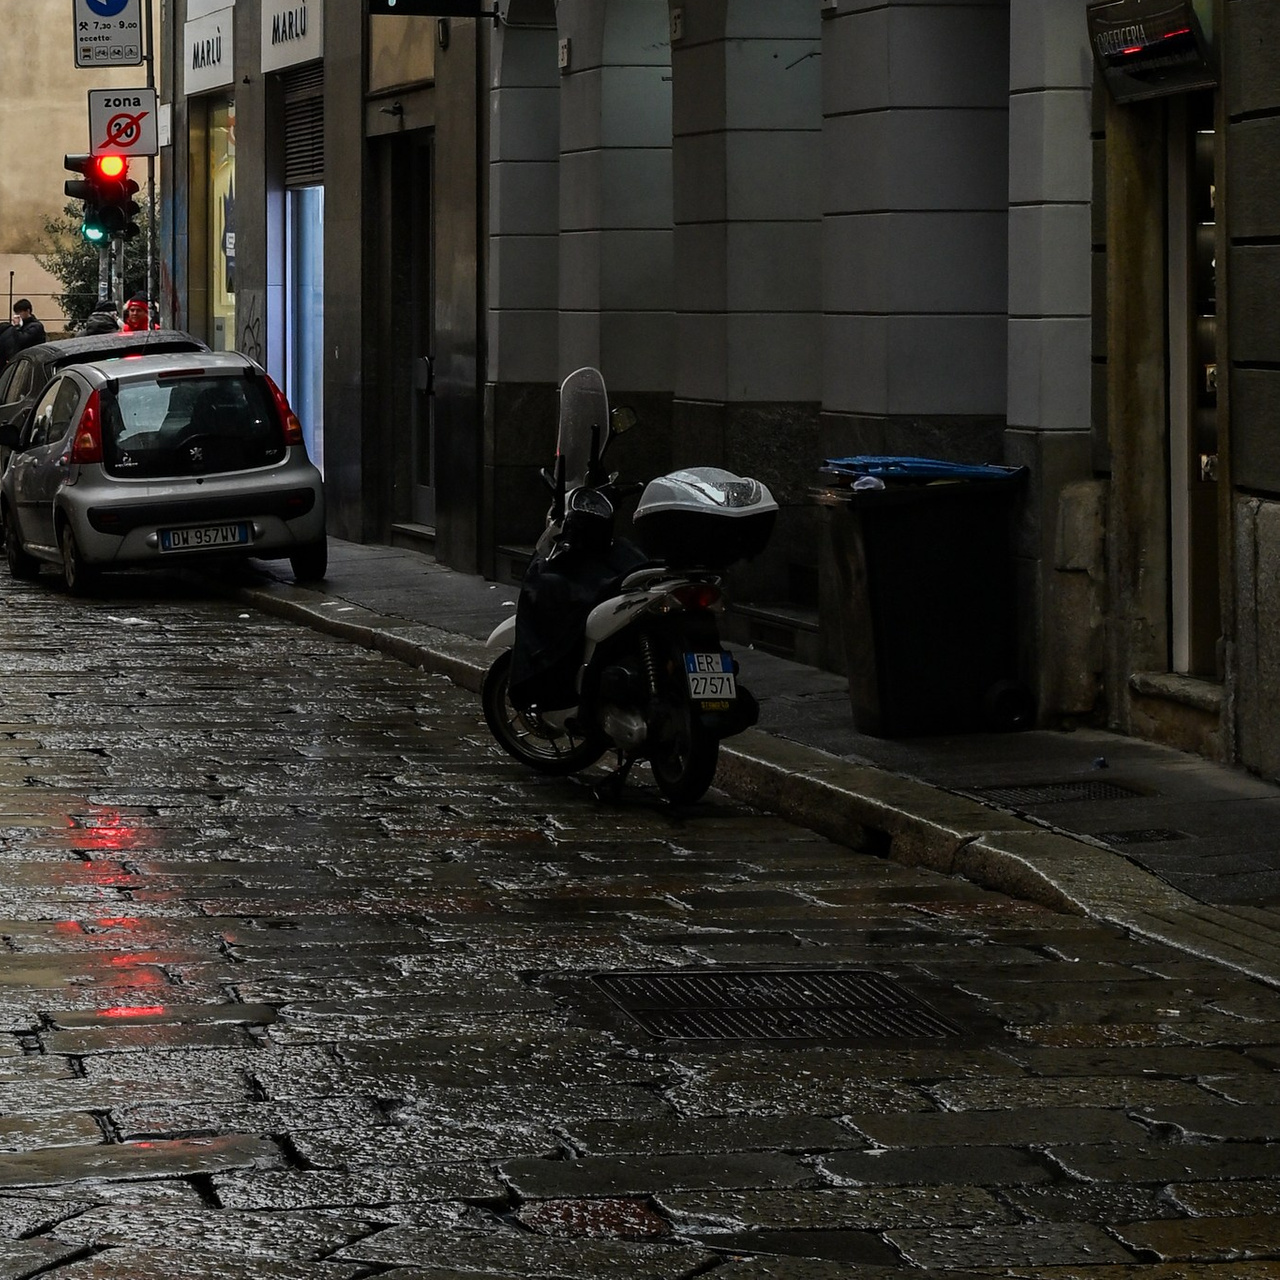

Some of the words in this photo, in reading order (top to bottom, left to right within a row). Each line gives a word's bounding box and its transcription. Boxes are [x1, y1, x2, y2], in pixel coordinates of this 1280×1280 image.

[192, 25, 222, 70] MARLÙ
[104, 97, 141, 108] zona
[696, 654, 715, 672] ER
[691, 677, 733, 695] 27571
